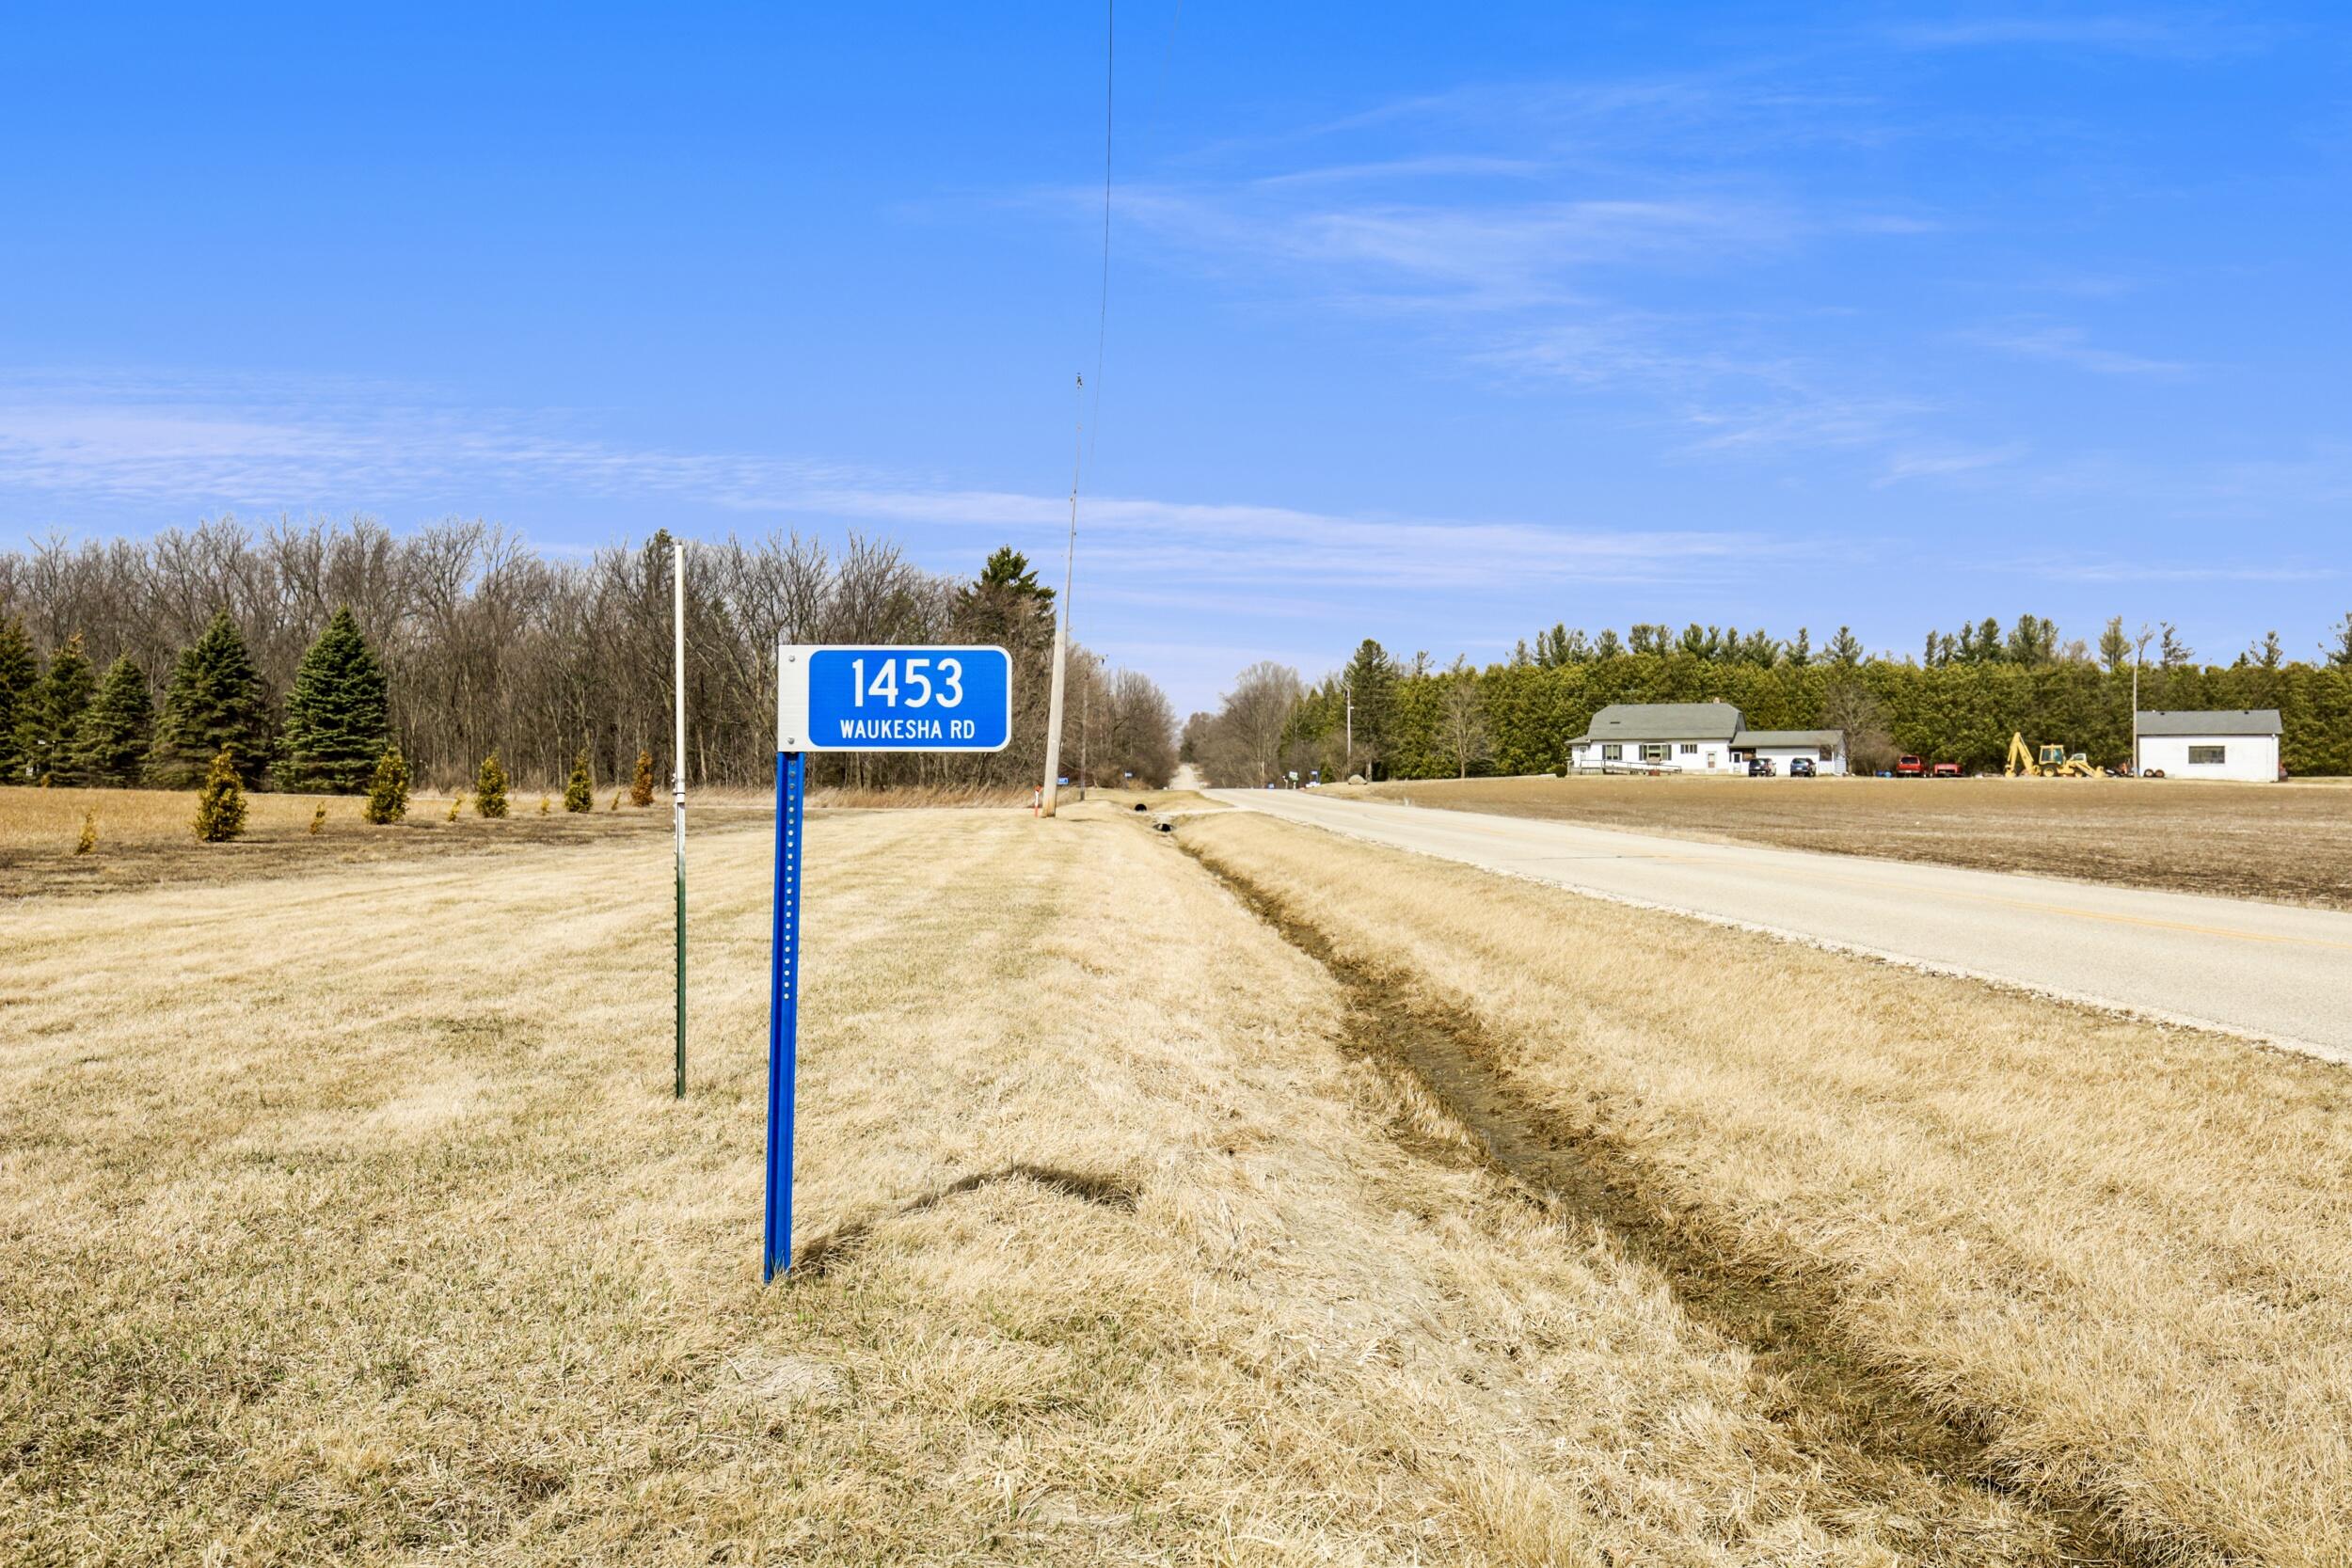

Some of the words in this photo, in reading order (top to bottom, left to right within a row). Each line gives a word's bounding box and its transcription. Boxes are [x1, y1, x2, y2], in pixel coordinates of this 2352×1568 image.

[851, 657, 963, 708] 1453
[840, 720, 943, 739] WAUKESHA
[950, 720, 976, 739] RD
